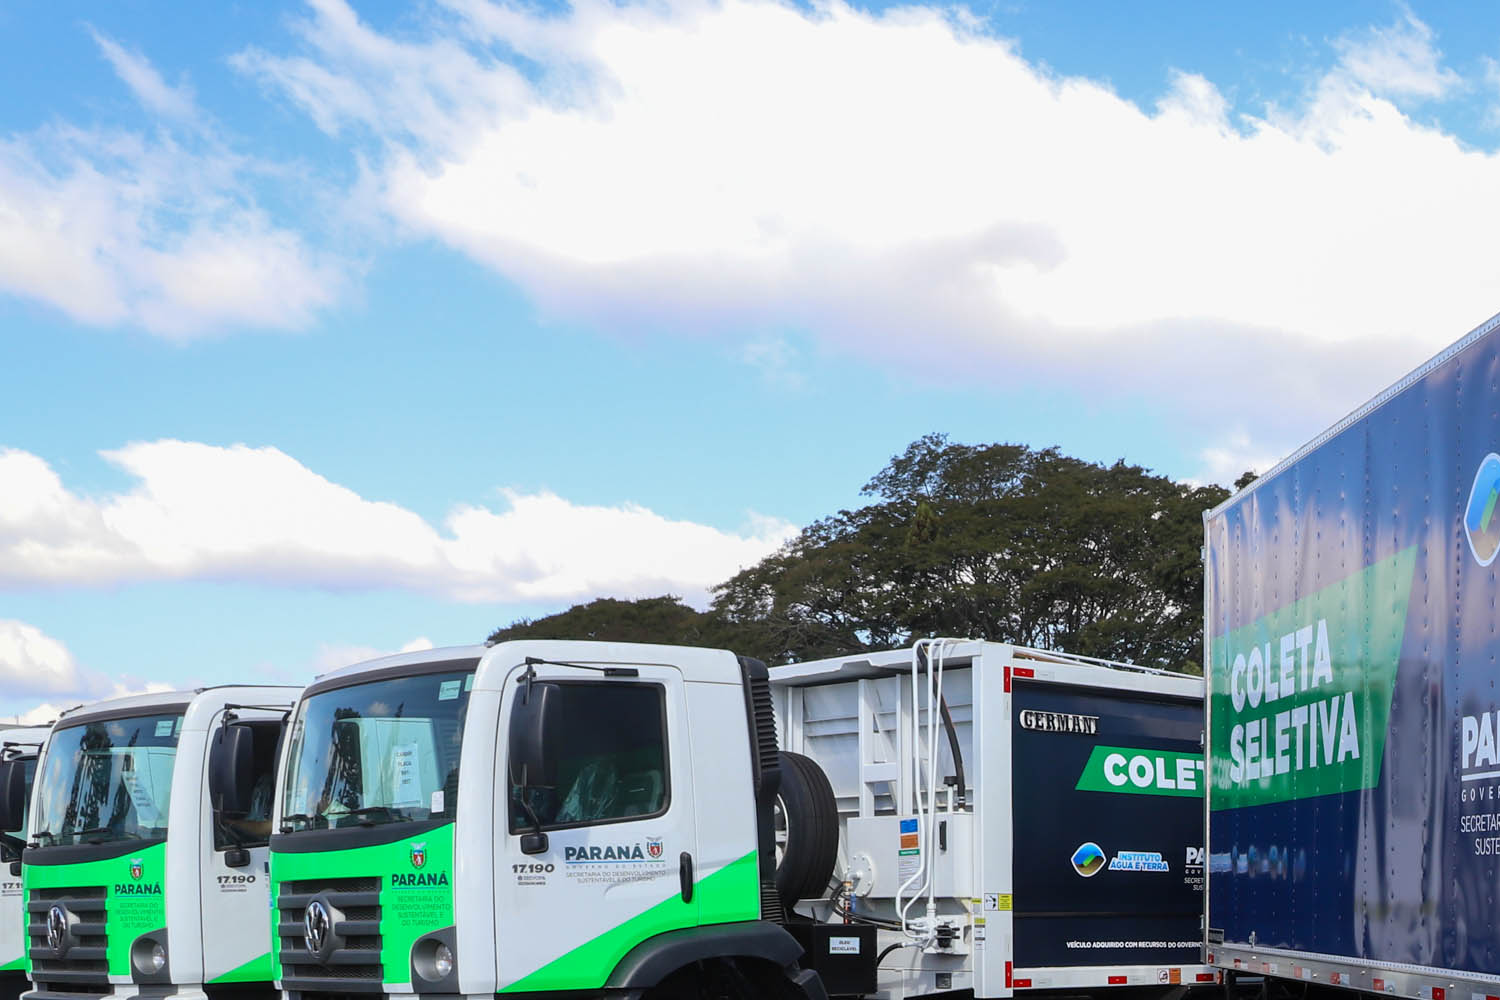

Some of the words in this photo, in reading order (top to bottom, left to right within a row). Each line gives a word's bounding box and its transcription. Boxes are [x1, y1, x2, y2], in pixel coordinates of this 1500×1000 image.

[1231, 618, 1333, 713] COLETA
[1230, 691, 1360, 783] SELETIVA
[1103, 753, 1204, 790] COLE
[564, 843, 645, 861] PARANÁ
[512, 864, 555, 873] 17.190
[1142, 862, 1168, 871] TERRA
[391, 870, 449, 886] PARANÁ
[115, 881, 162, 895] PARANÁ
[1066, 940, 1091, 949] VEÍCULO
[1125, 941, 1138, 949] COM
